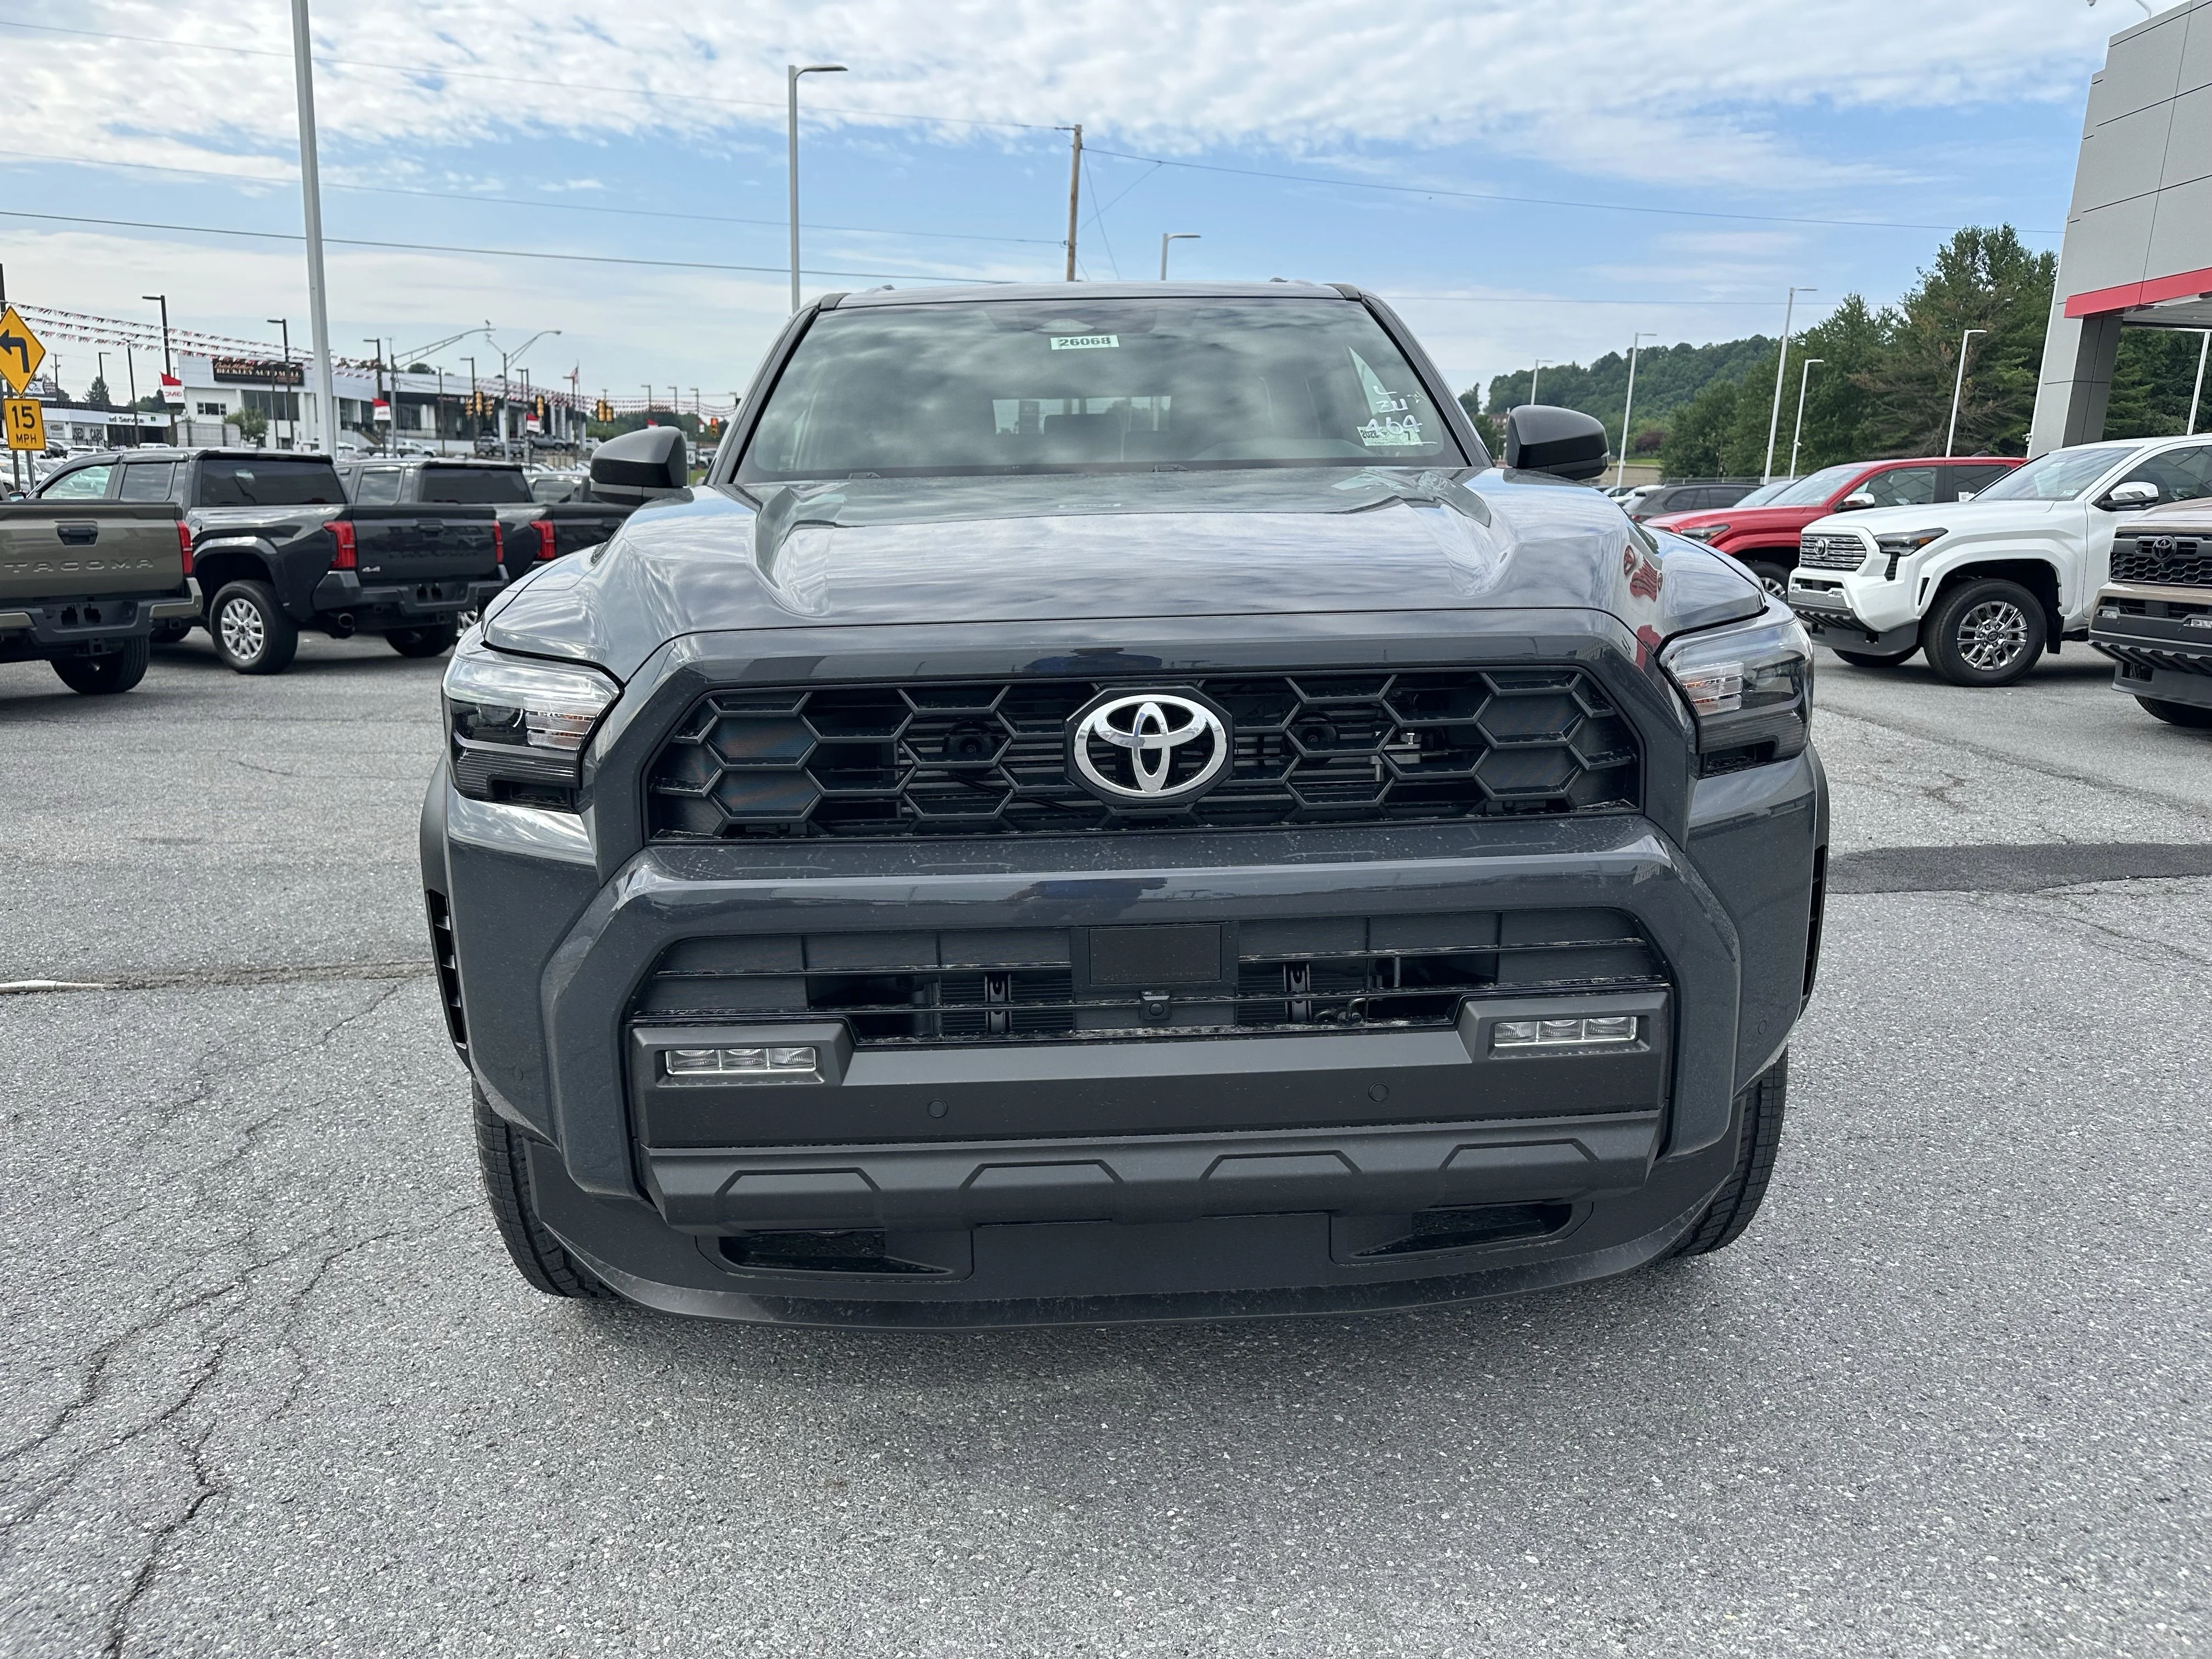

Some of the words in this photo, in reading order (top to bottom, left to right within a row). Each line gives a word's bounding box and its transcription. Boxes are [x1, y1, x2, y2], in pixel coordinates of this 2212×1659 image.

[1059, 337, 1111, 346] 26068
[12, 403, 36, 430] 15
[15, 433, 37, 444] MPH
[4, 558, 154, 573] TACOMA
